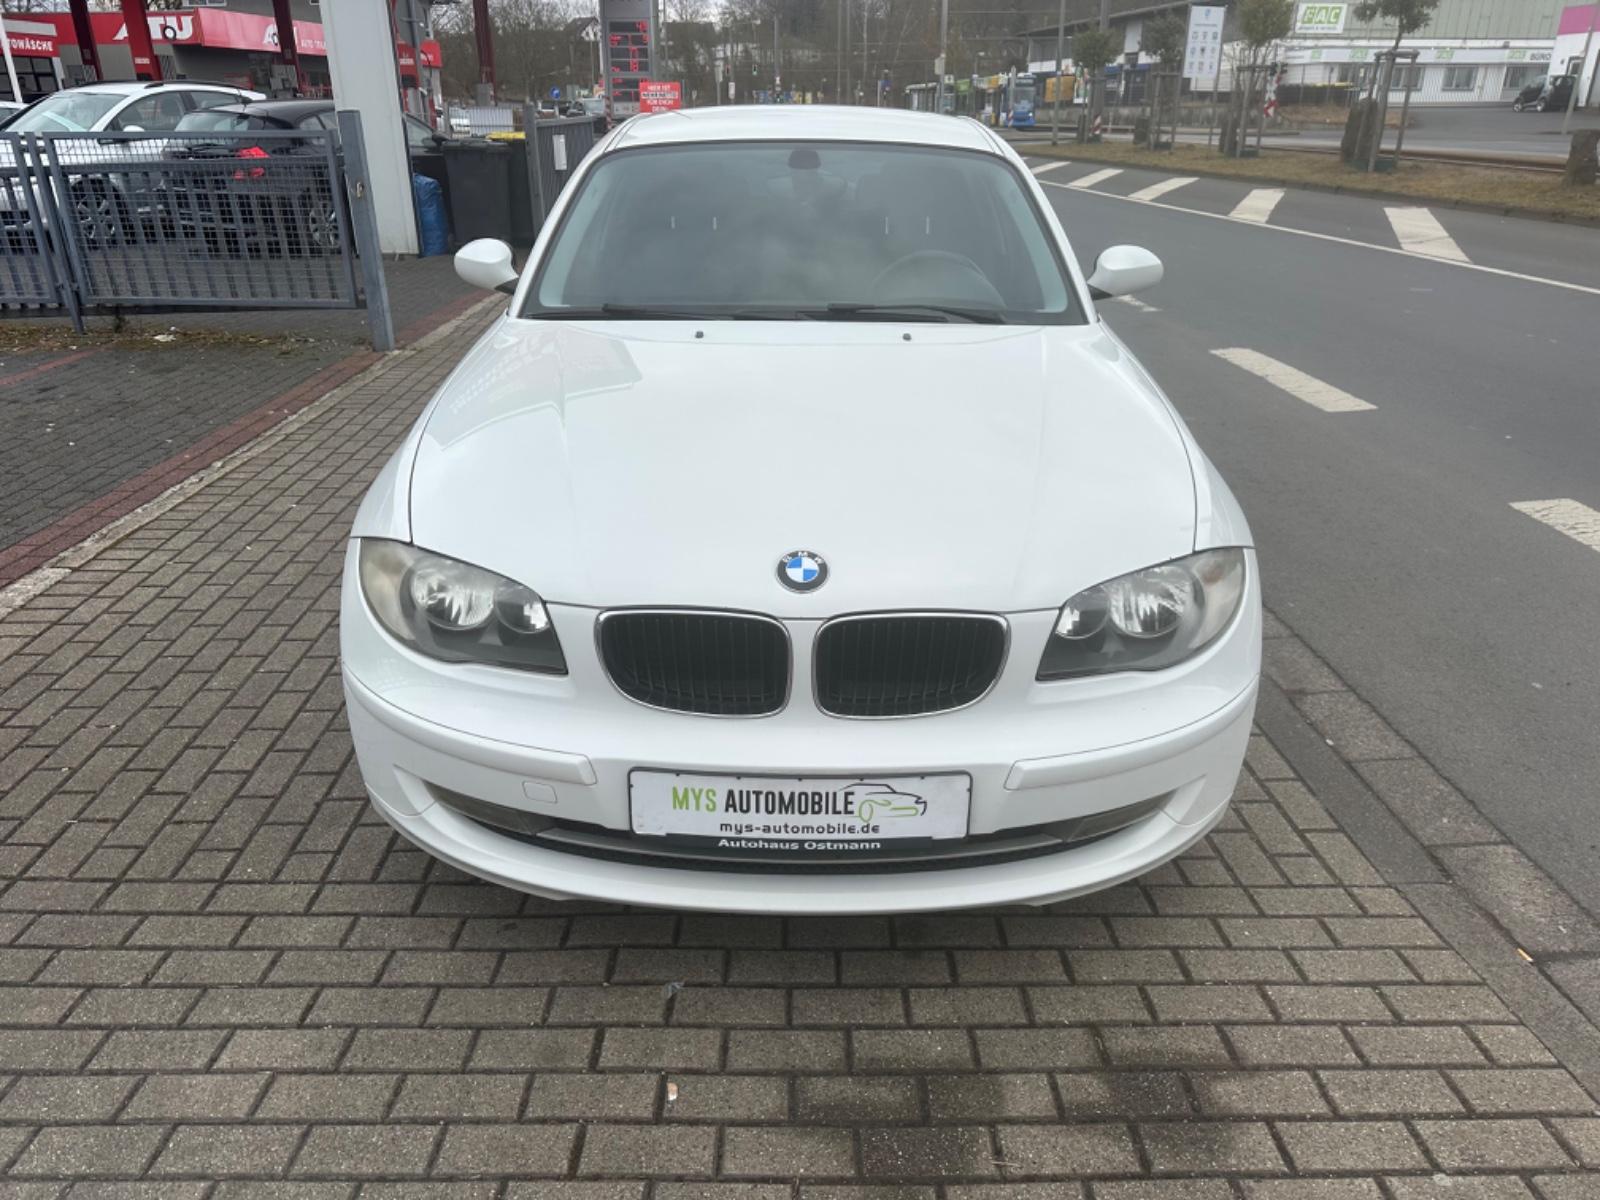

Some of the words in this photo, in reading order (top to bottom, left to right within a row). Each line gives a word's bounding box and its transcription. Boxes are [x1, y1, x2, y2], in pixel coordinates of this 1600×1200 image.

[672, 787, 717, 813] MYS
[725, 789, 855, 815] AUTOMOBILE
[720, 822, 880, 836] mys-automobile.de
[718, 839, 800, 850] Autohaus
[804, 840, 882, 850] Ostmann
